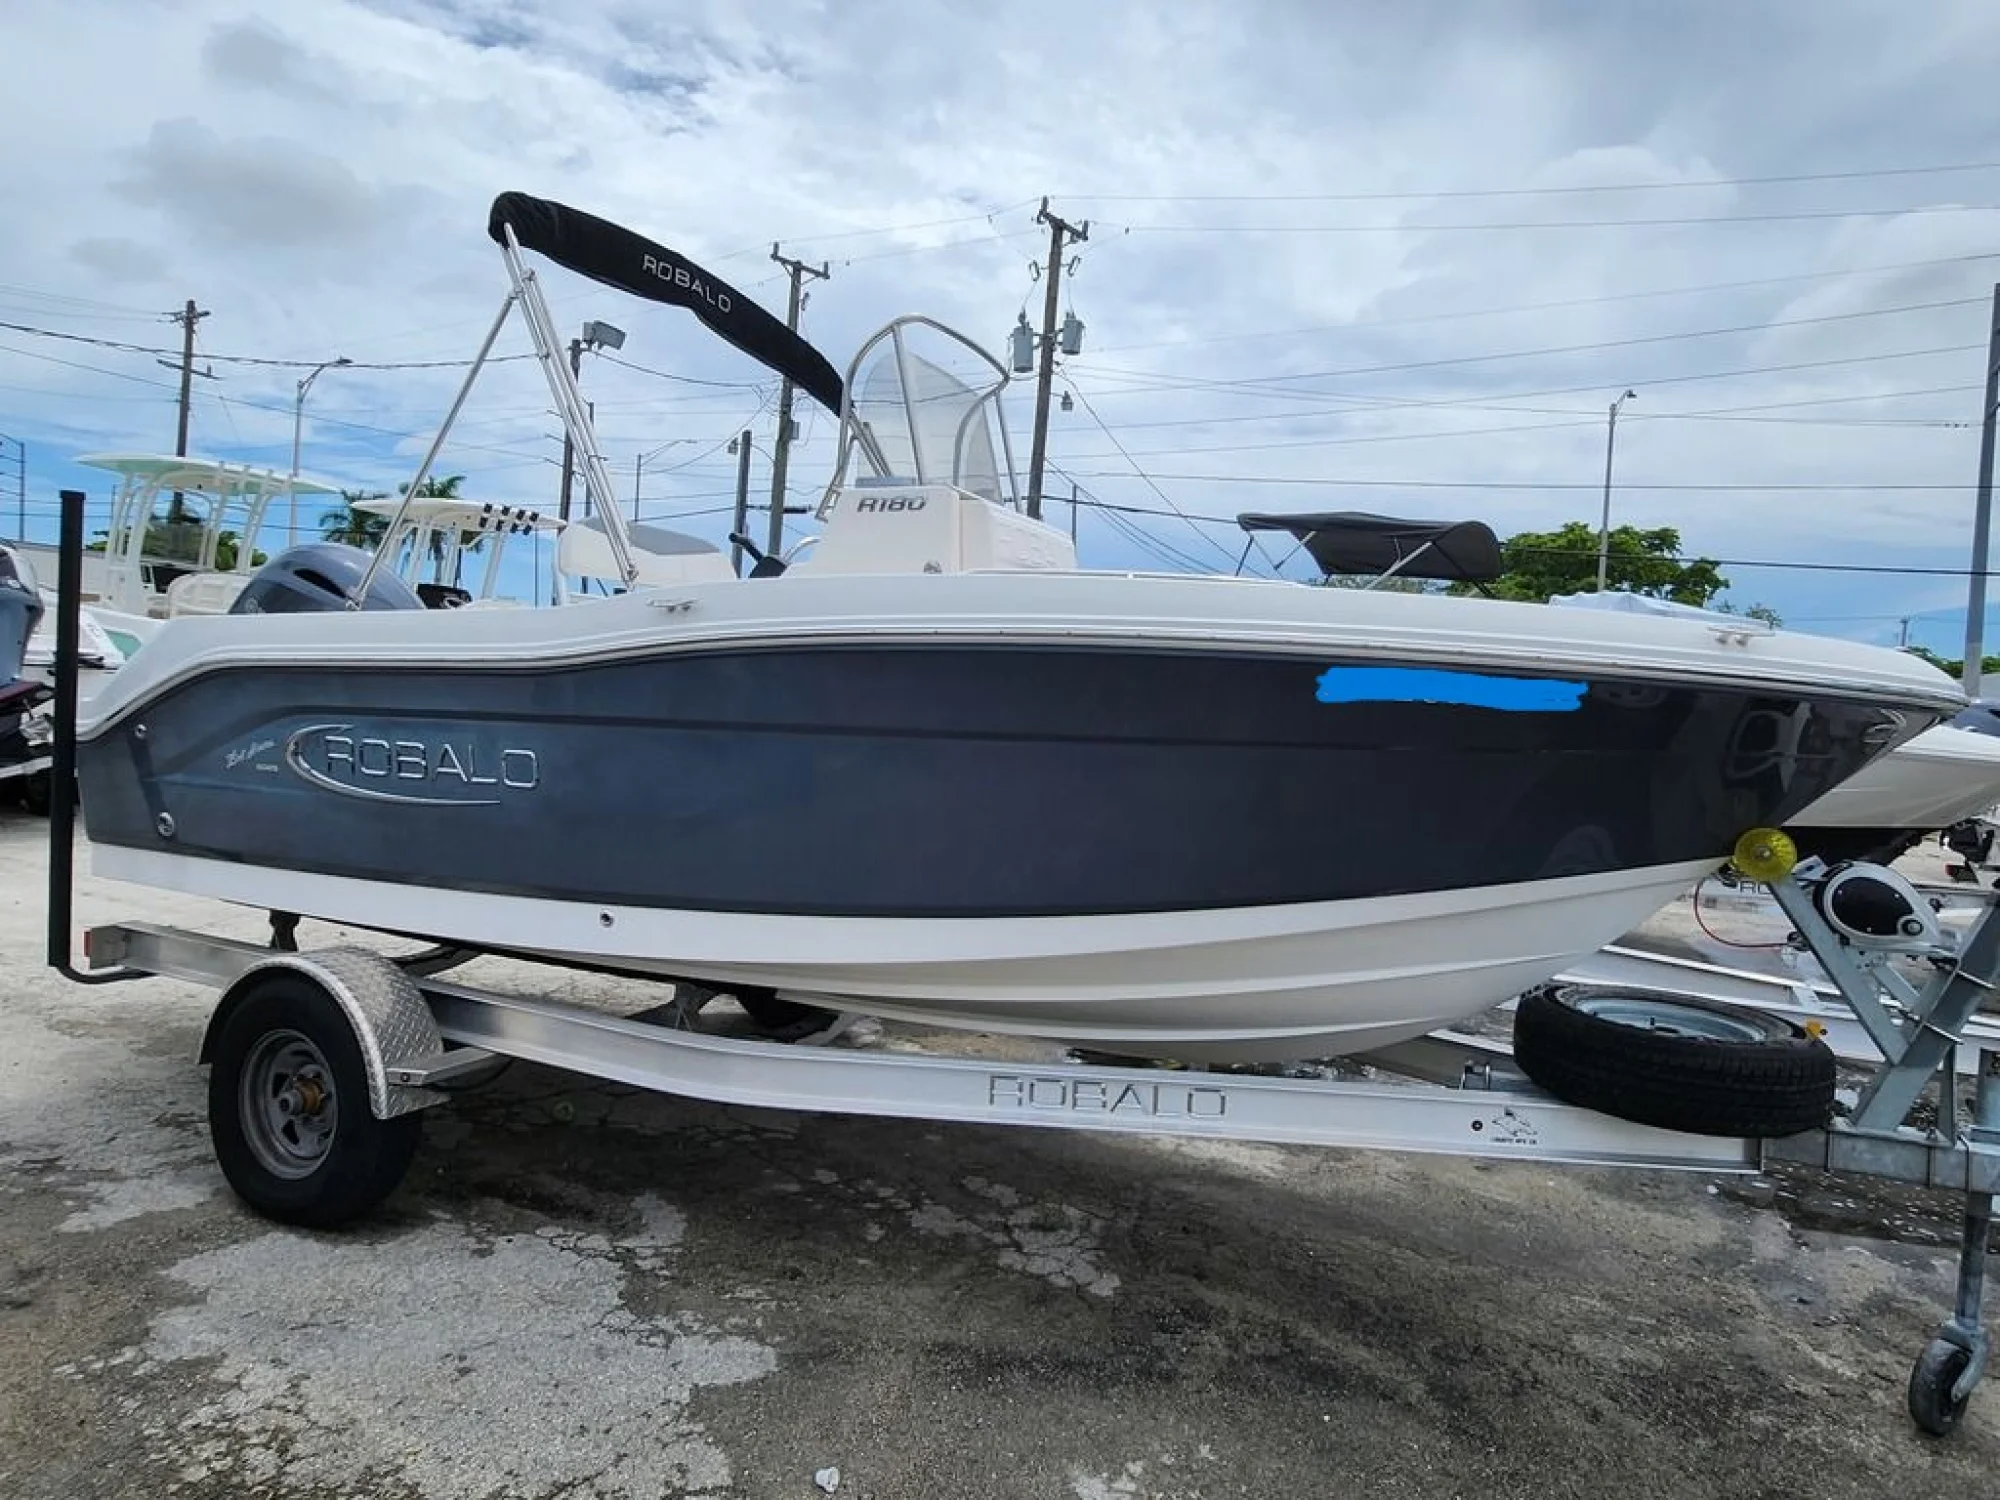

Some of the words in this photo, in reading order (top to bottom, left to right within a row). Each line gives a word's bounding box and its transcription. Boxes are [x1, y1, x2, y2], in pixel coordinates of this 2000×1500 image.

[642, 253, 732, 313] ROBALO
[857, 496, 926, 512] R180
[324, 735, 539, 788] ROBALO
[989, 1075, 1226, 1119] ROBALO
